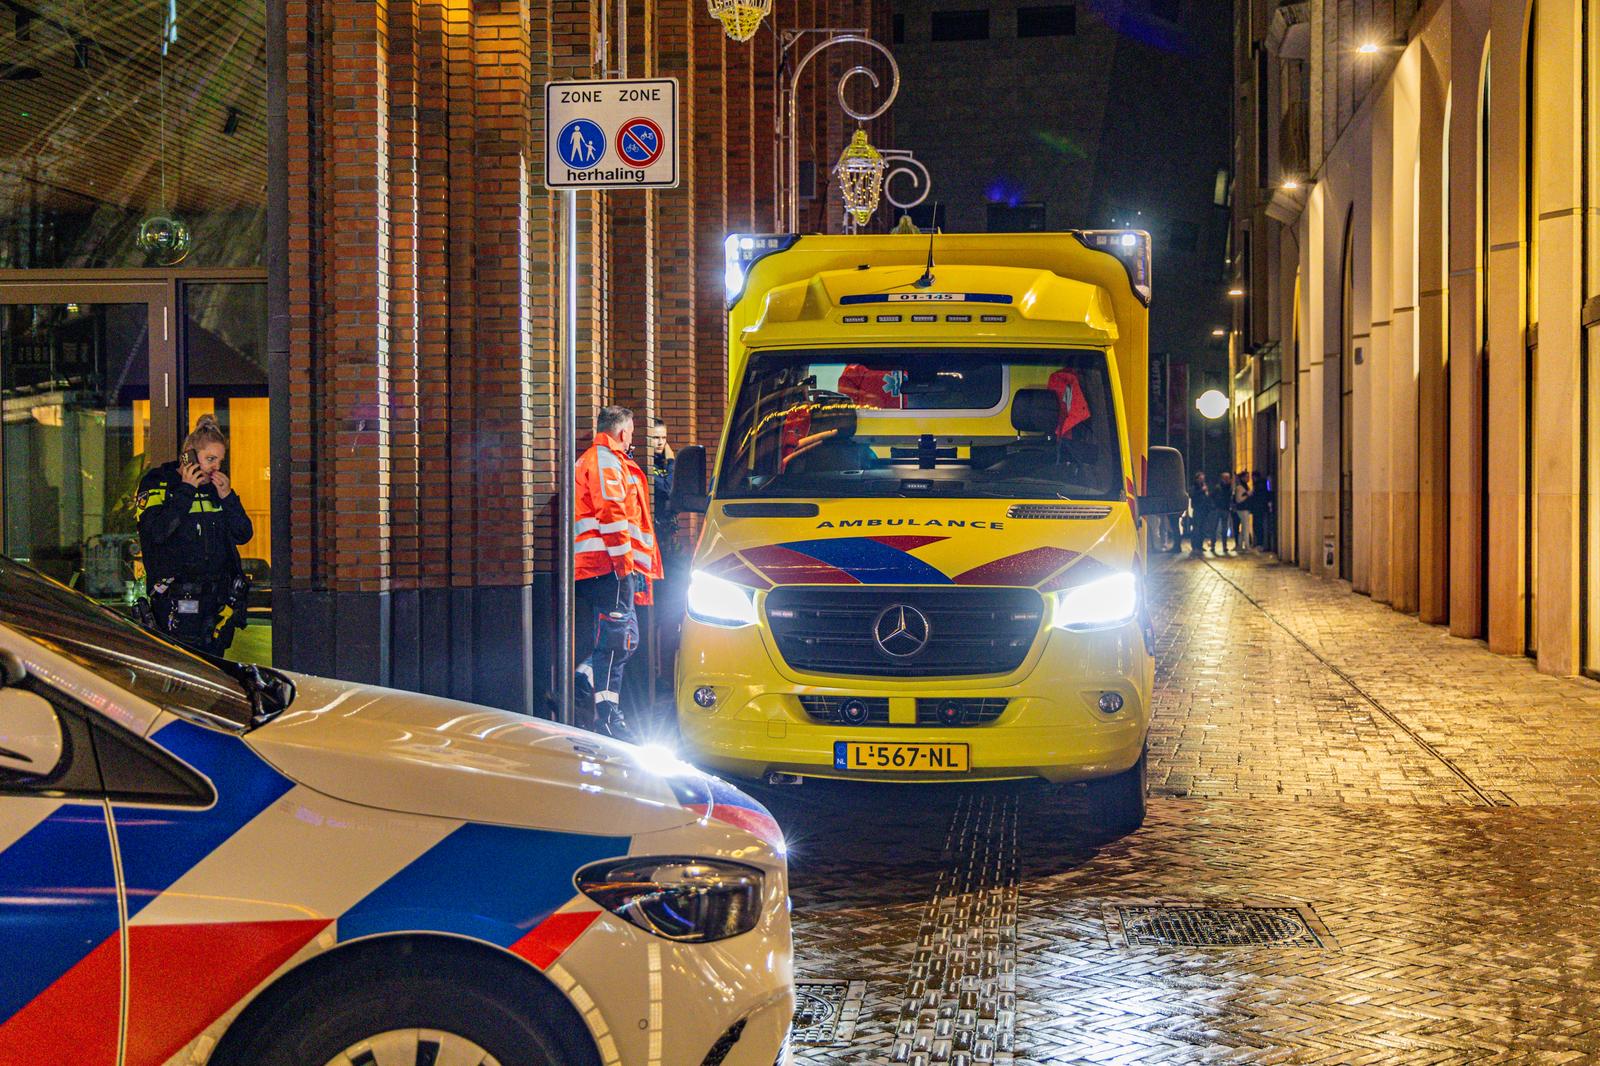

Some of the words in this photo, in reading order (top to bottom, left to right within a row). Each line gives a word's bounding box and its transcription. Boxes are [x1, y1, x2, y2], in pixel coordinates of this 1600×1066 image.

[561, 91, 602, 103] ZONE
[619, 89, 661, 101] ZONE
[567, 168, 645, 182] herhaling
[816, 519, 1004, 530] AMBULANCE
